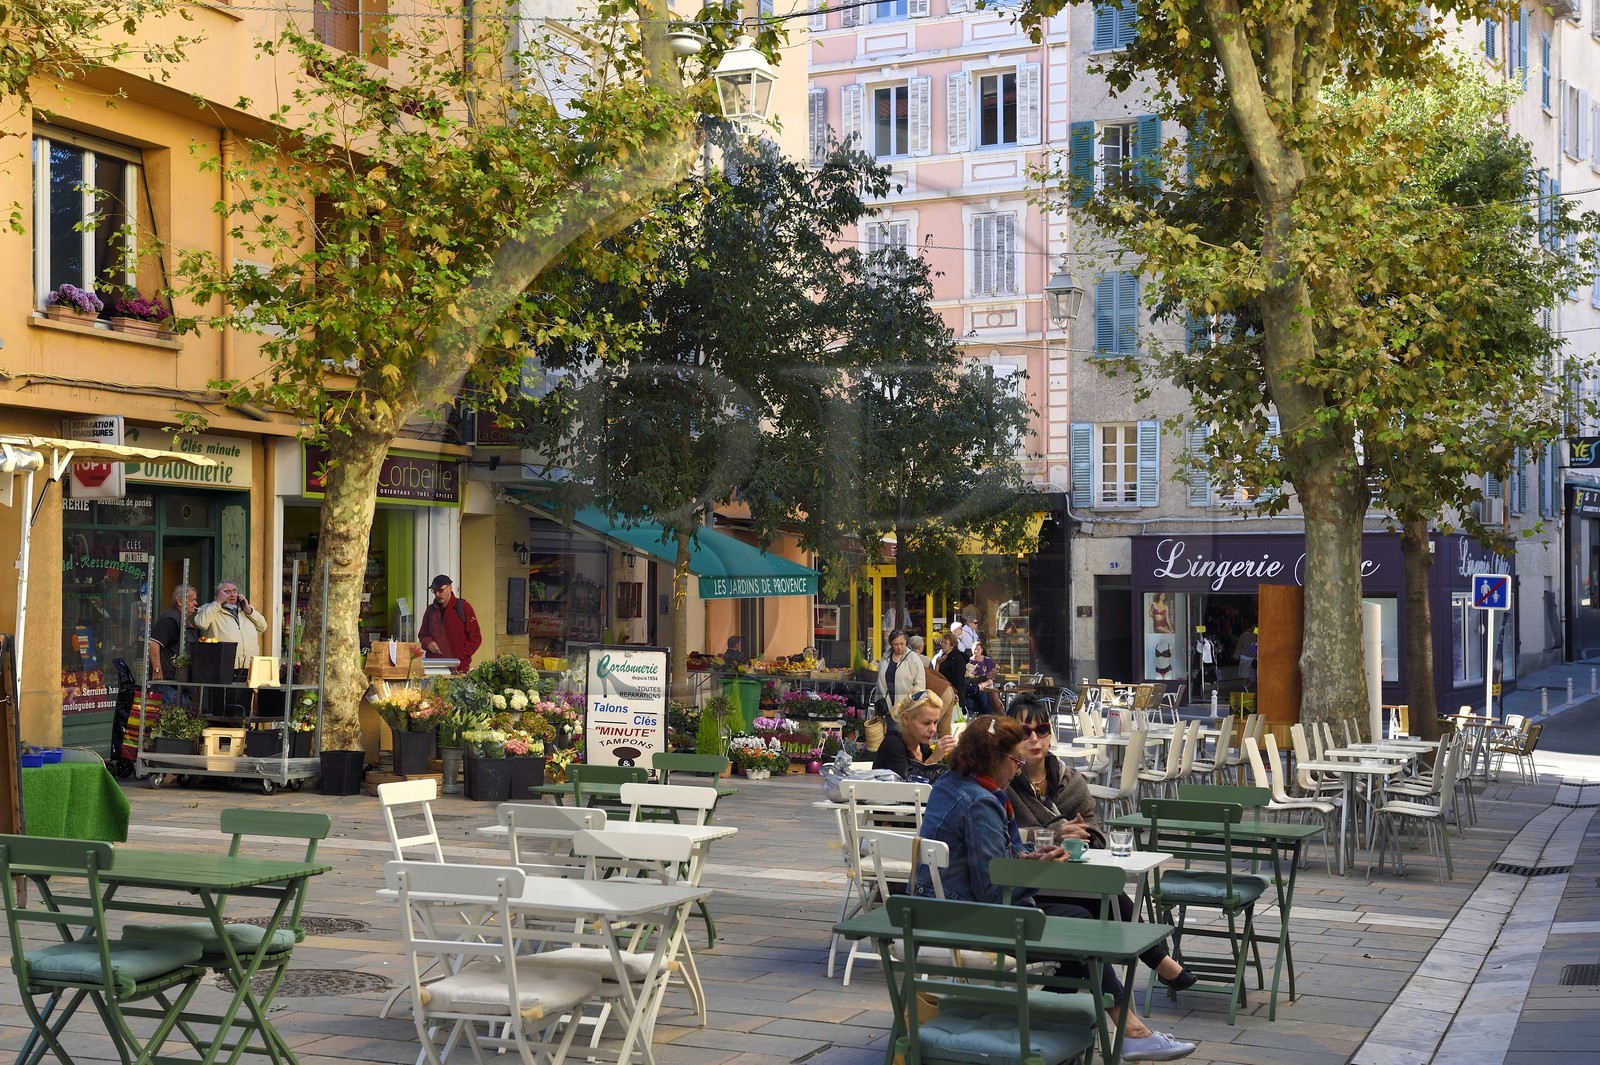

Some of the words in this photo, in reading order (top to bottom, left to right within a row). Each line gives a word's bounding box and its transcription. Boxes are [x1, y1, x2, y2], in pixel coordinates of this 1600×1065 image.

[72, 420, 114, 429] REPARATION
[72, 429, 114, 438] CHAUSSURES
[180, 438, 202, 452] Clés
[206, 445, 241, 457] minute
[380, 488, 410, 496] ORIENTAUX
[125, 498, 134, 506] de
[134, 499, 152, 509] portes
[126, 540, 142, 550] CLES
[125, 553, 143, 562] MINUTE
[80, 554, 147, 580] Ressemelage
[1153, 538, 1284, 591] Lingerie
[714, 579, 727, 595] LES
[729, 578, 760, 594] JARDINS
[762, 578, 772, 593] DE
[773, 577, 807, 593] PROVENCE
[596, 654, 659, 679] Cordonnerie
[619, 691, 661, 699] REPARATIONS
[593, 702, 629, 714] Talons
[633, 715, 657, 726] Clés
[595, 726, 656, 738] "MINUTE"
[599, 738, 654, 750] TAMPONS
